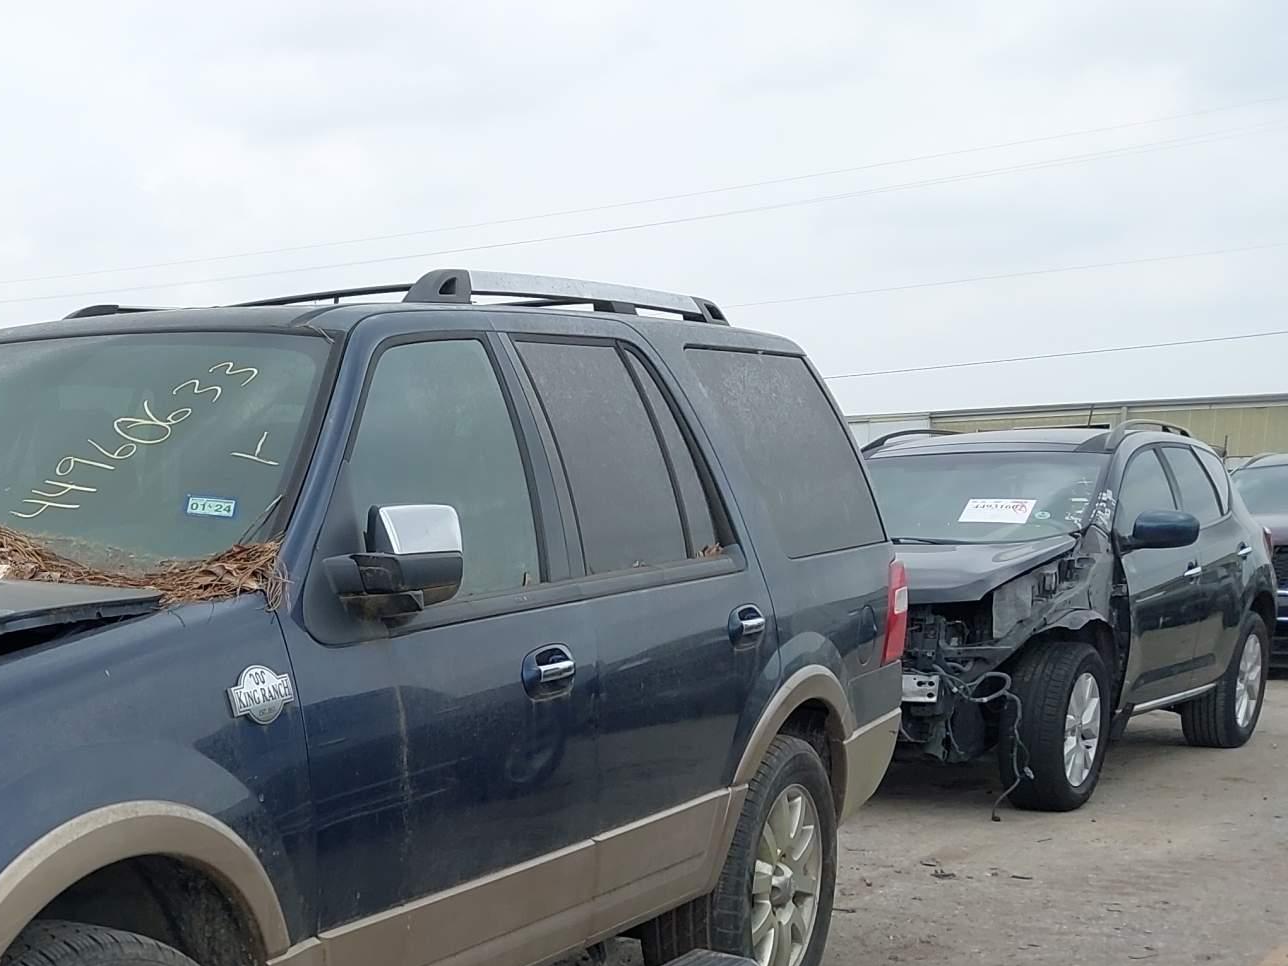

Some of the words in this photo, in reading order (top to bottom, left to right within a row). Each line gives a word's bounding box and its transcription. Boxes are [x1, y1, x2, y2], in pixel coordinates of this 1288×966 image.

[9, 361, 259, 518] 44960633
[235, 689, 261, 709] KING
[260, 679, 292, 703] RANCH
